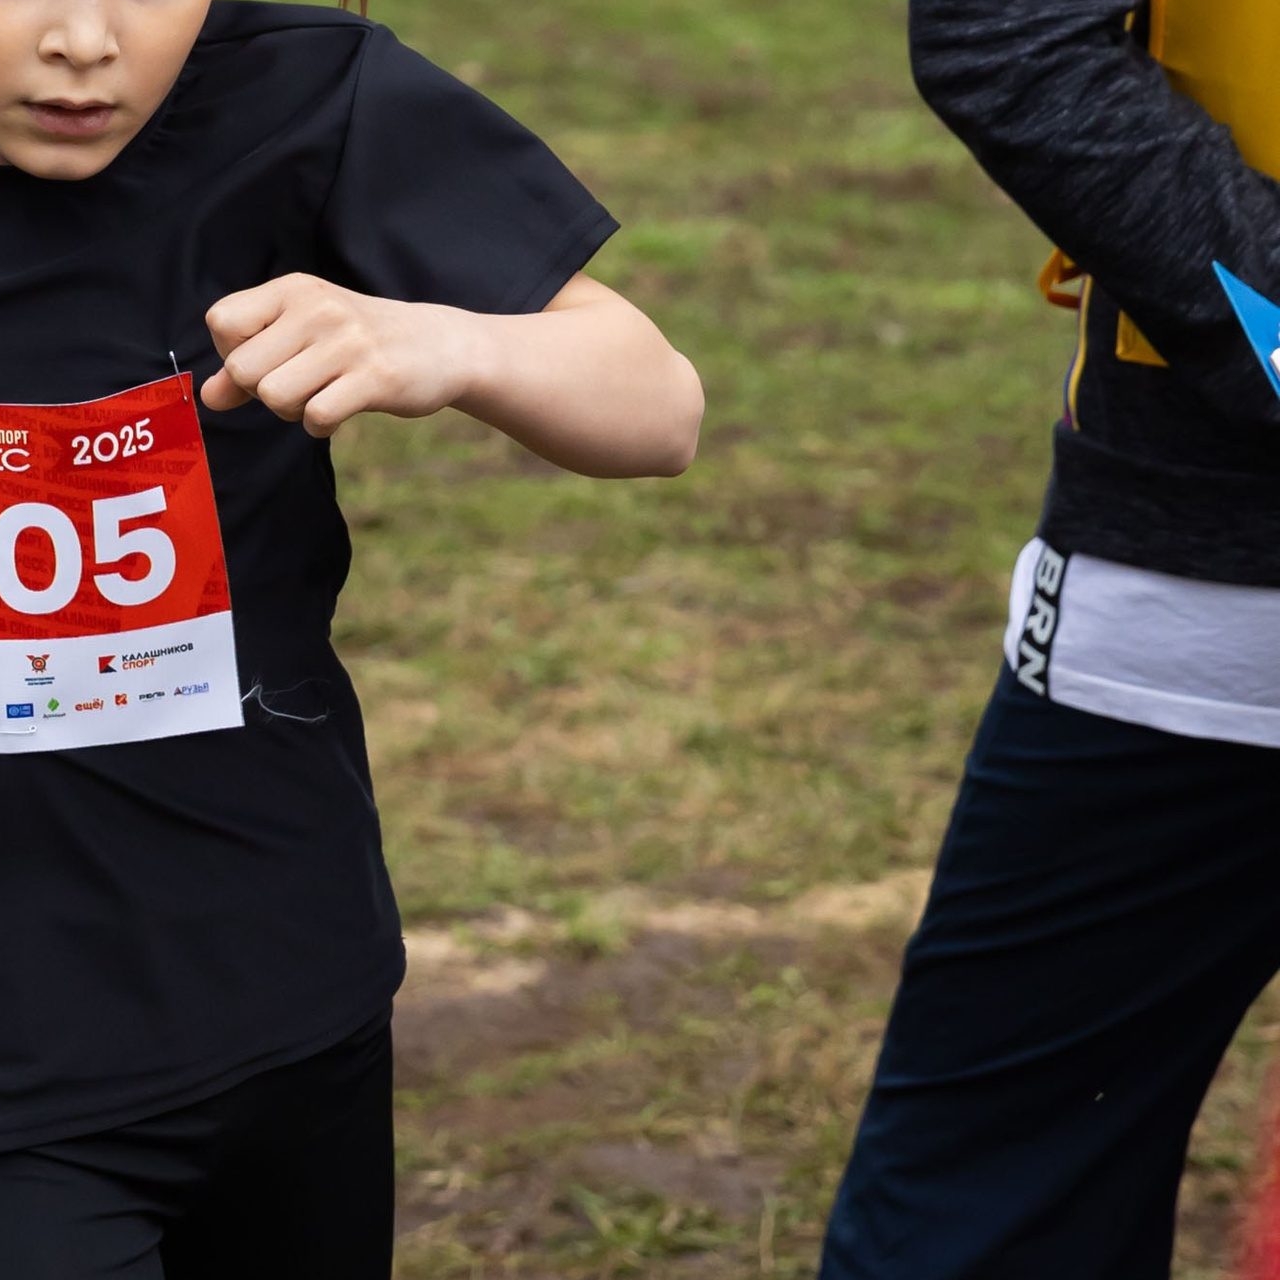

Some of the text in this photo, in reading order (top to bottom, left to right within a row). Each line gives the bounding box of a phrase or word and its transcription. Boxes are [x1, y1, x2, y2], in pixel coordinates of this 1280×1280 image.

[71, 418, 154, 465] 2025
[1017, 546, 1066, 696] BRN
[122, 642, 194, 662] КАЛАШНИКОВ
[122, 658, 156, 671] СПОРТ
[75, 698, 104, 711] ещё!
